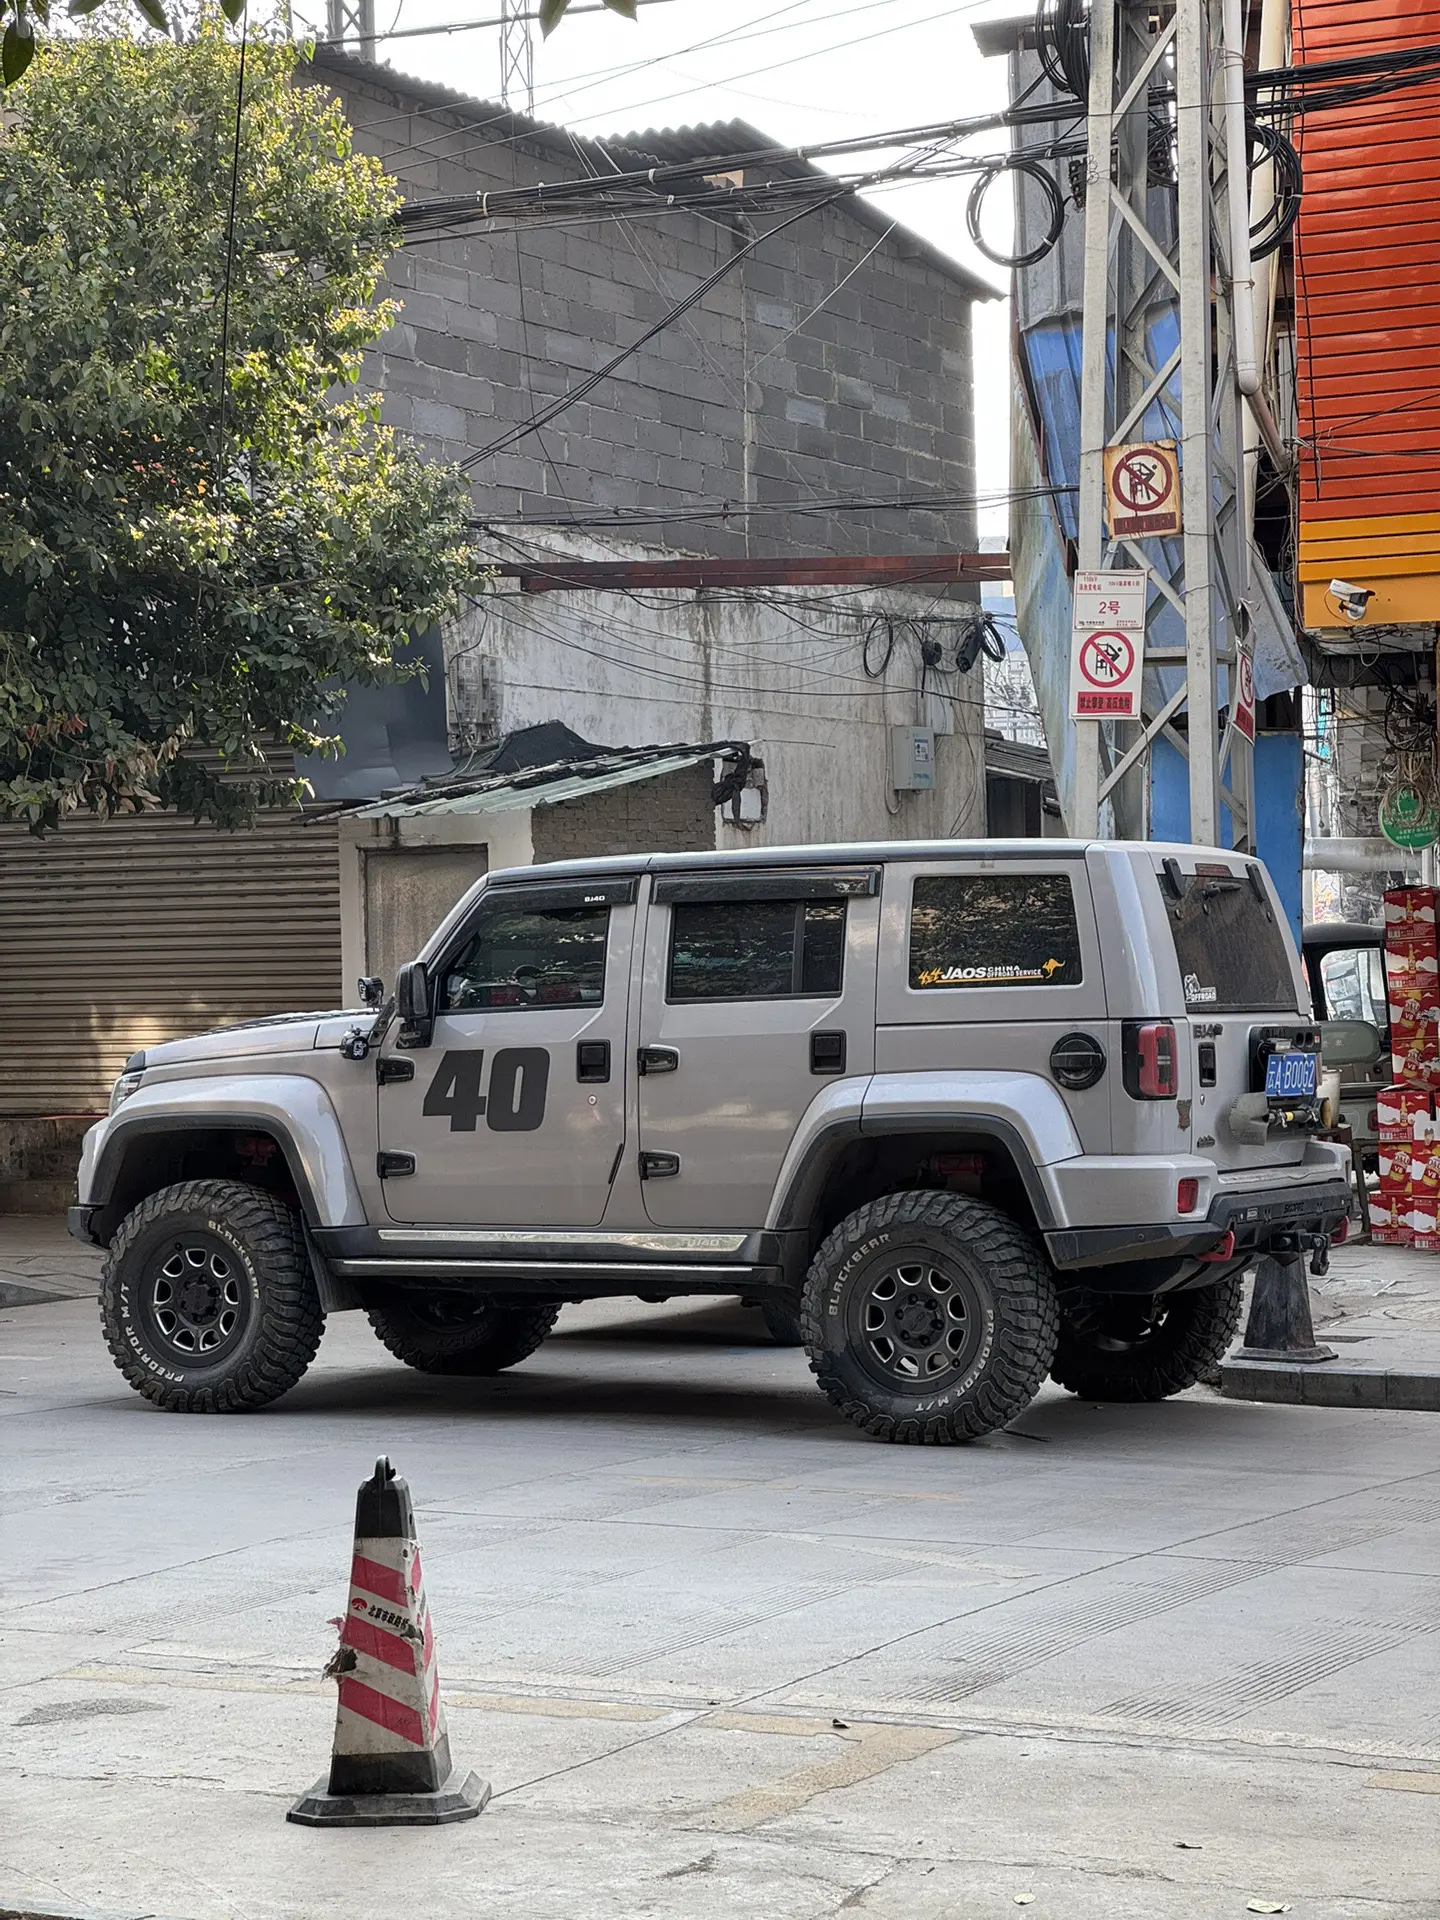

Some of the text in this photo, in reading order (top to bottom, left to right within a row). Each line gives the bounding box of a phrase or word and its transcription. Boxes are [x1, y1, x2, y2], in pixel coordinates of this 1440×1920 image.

[1098, 600, 1121, 615] 2号
[584, 895, 606, 903] BJ40
[941, 966, 987, 980] JAOS
[986, 970, 1014, 978] OFFROAD
[1191, 993, 1216, 1001] OFFROAD
[1193, 1024, 1222, 1039] BJ4
[422, 1047, 550, 1132] 40
[208, 1219, 260, 1299] BLACKBEAR
[829, 1233, 891, 1316] BLACKBEAR
[125, 1324, 185, 1382] PREDATOR
[955, 1309, 995, 1399] PREDATOR
